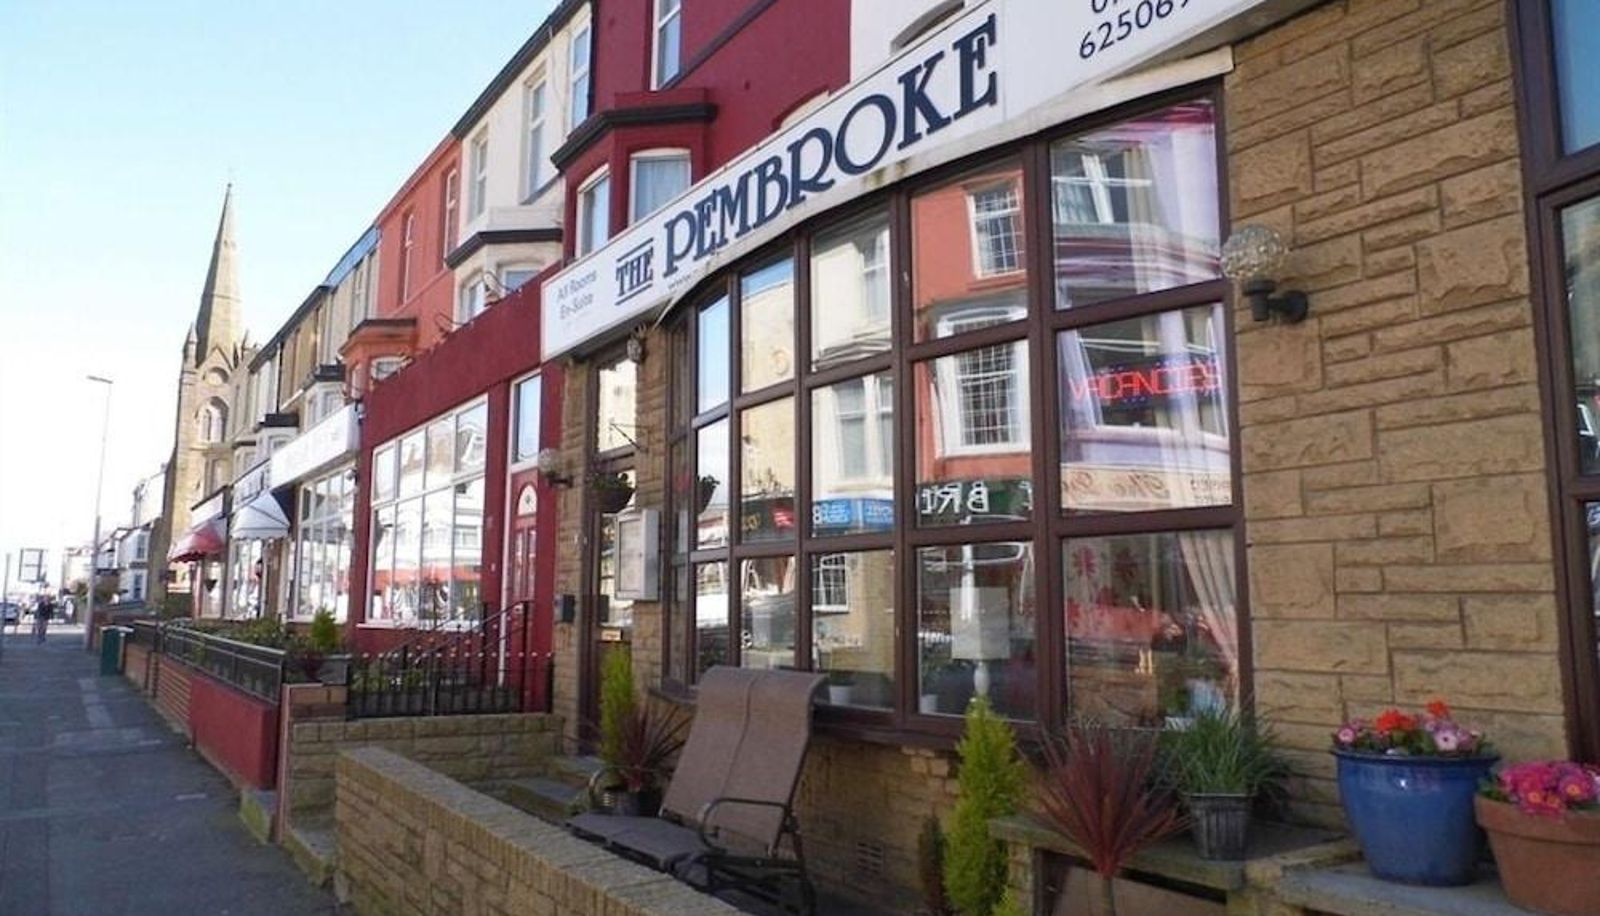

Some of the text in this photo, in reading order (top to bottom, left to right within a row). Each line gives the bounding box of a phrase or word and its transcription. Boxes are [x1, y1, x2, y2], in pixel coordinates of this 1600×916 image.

[1079, 0, 1188, 59] 62506
[616, 13, 998, 297] THE PEMBROKE
